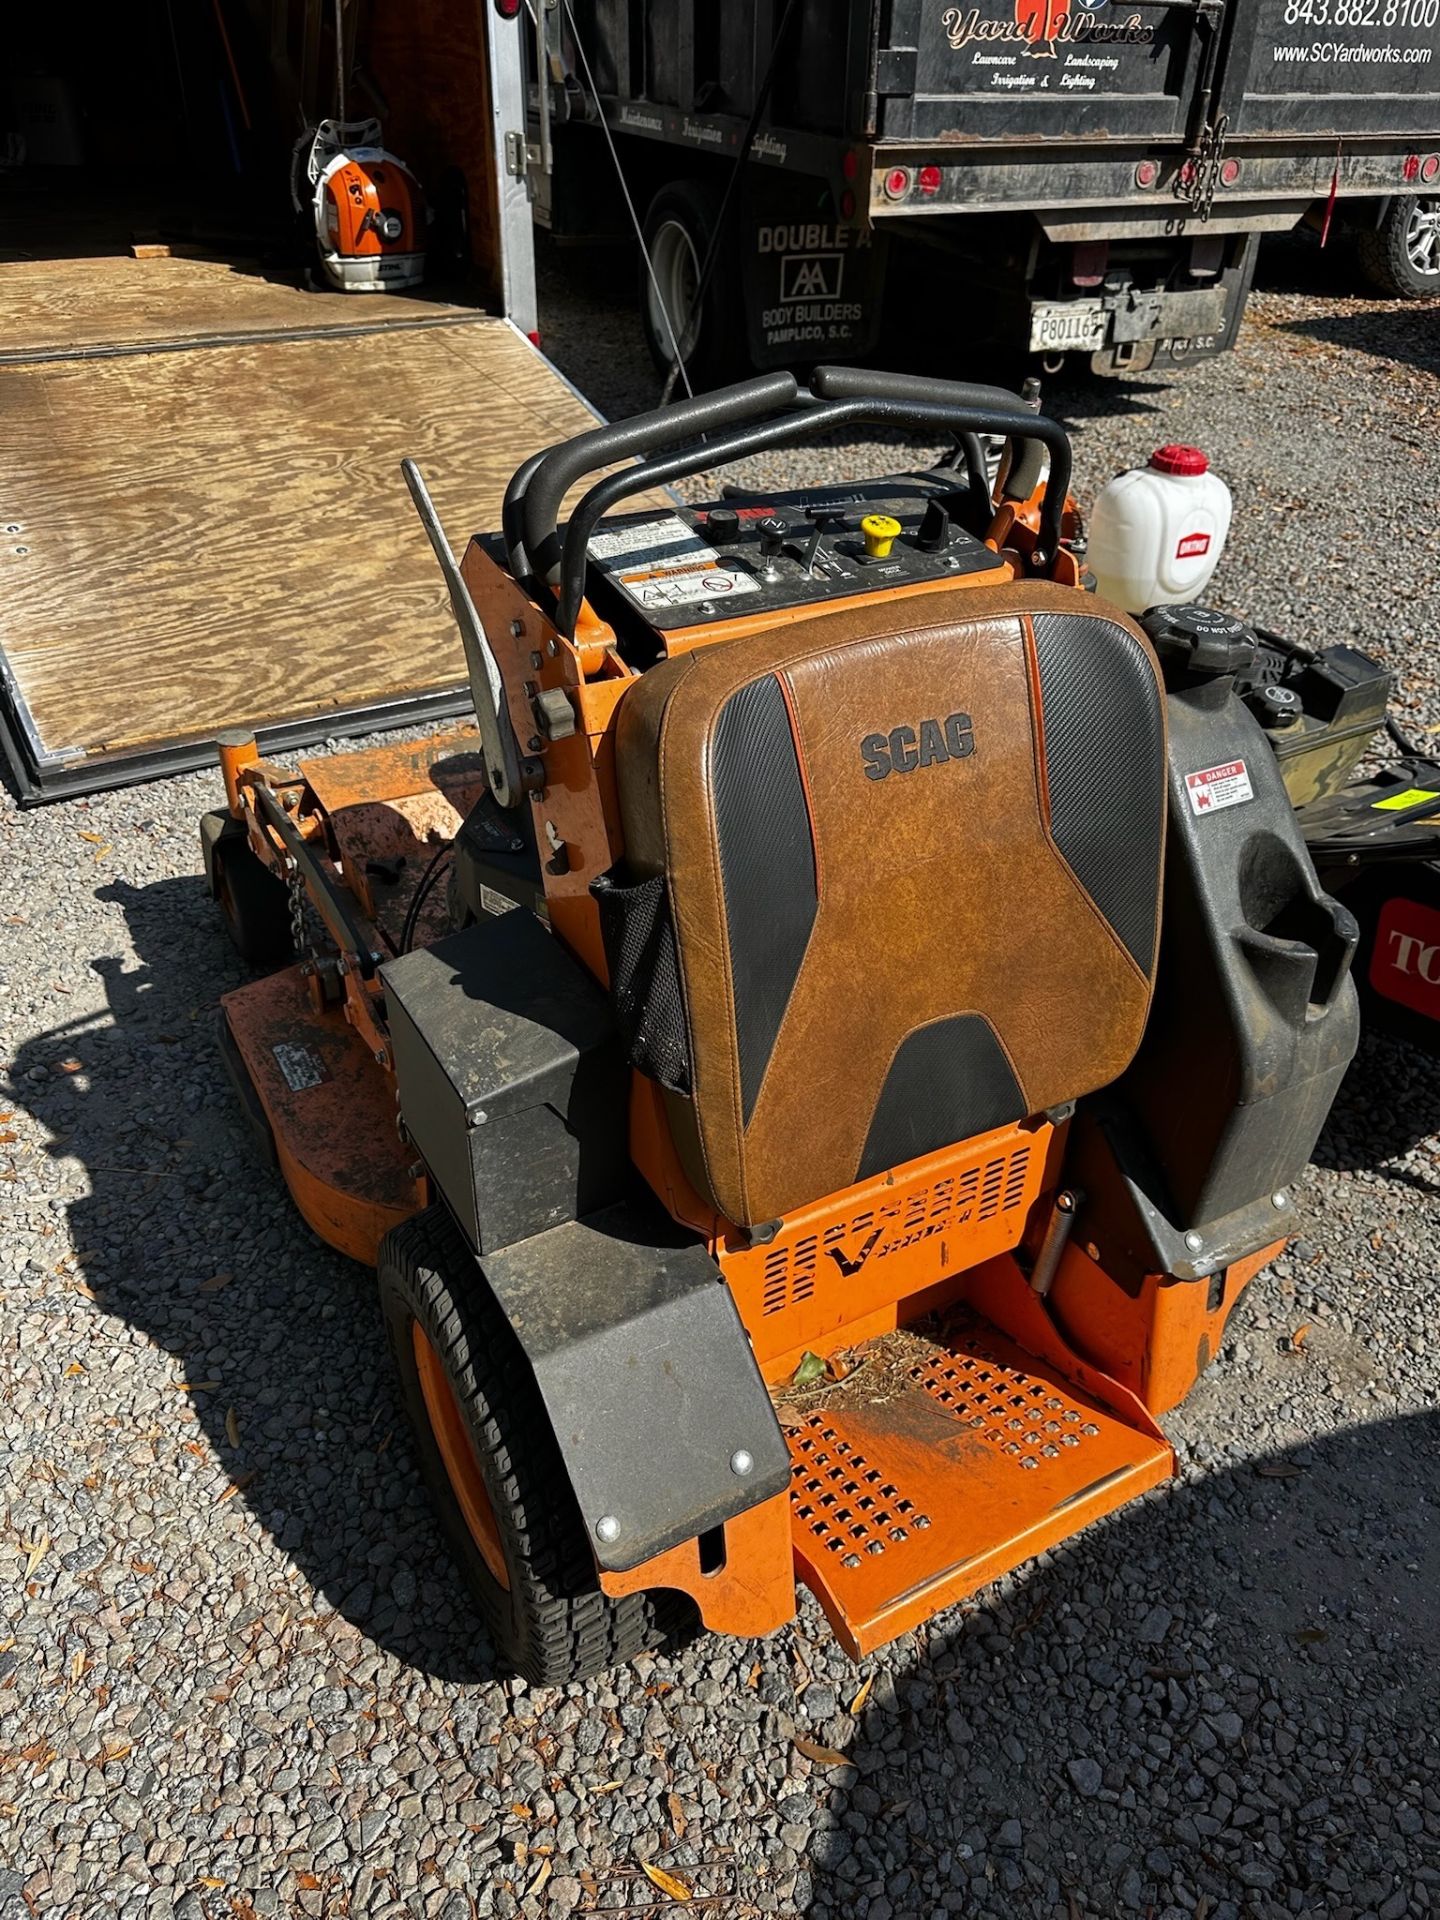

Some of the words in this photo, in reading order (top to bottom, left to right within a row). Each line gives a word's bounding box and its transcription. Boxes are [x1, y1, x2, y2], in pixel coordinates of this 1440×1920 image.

[1283, 0, 1440, 27] 843.882.8100
[941, 8, 1039, 49] Yard
[1053, 12, 1155, 44] Works
[971, 52, 1016, 66] Lawncare
[1064, 54, 1119, 70] Landscaping
[1273, 42, 1432, 63] www.SCYardworks.com
[990, 72, 1036, 89] Irrigation
[1040, 75, 1049, 88] &
[1059, 73, 1096, 90] Lighting
[757, 223, 849, 254] DOUBLE
[761, 306, 795, 329] BODY
[795, 303, 863, 325] BUILDERS
[766, 324, 825, 346] PAMPLICO,
[828, 323, 853, 339] S.C.
[860, 712, 976, 781] SCAG
[1205, 766, 1237, 781] DANGER
